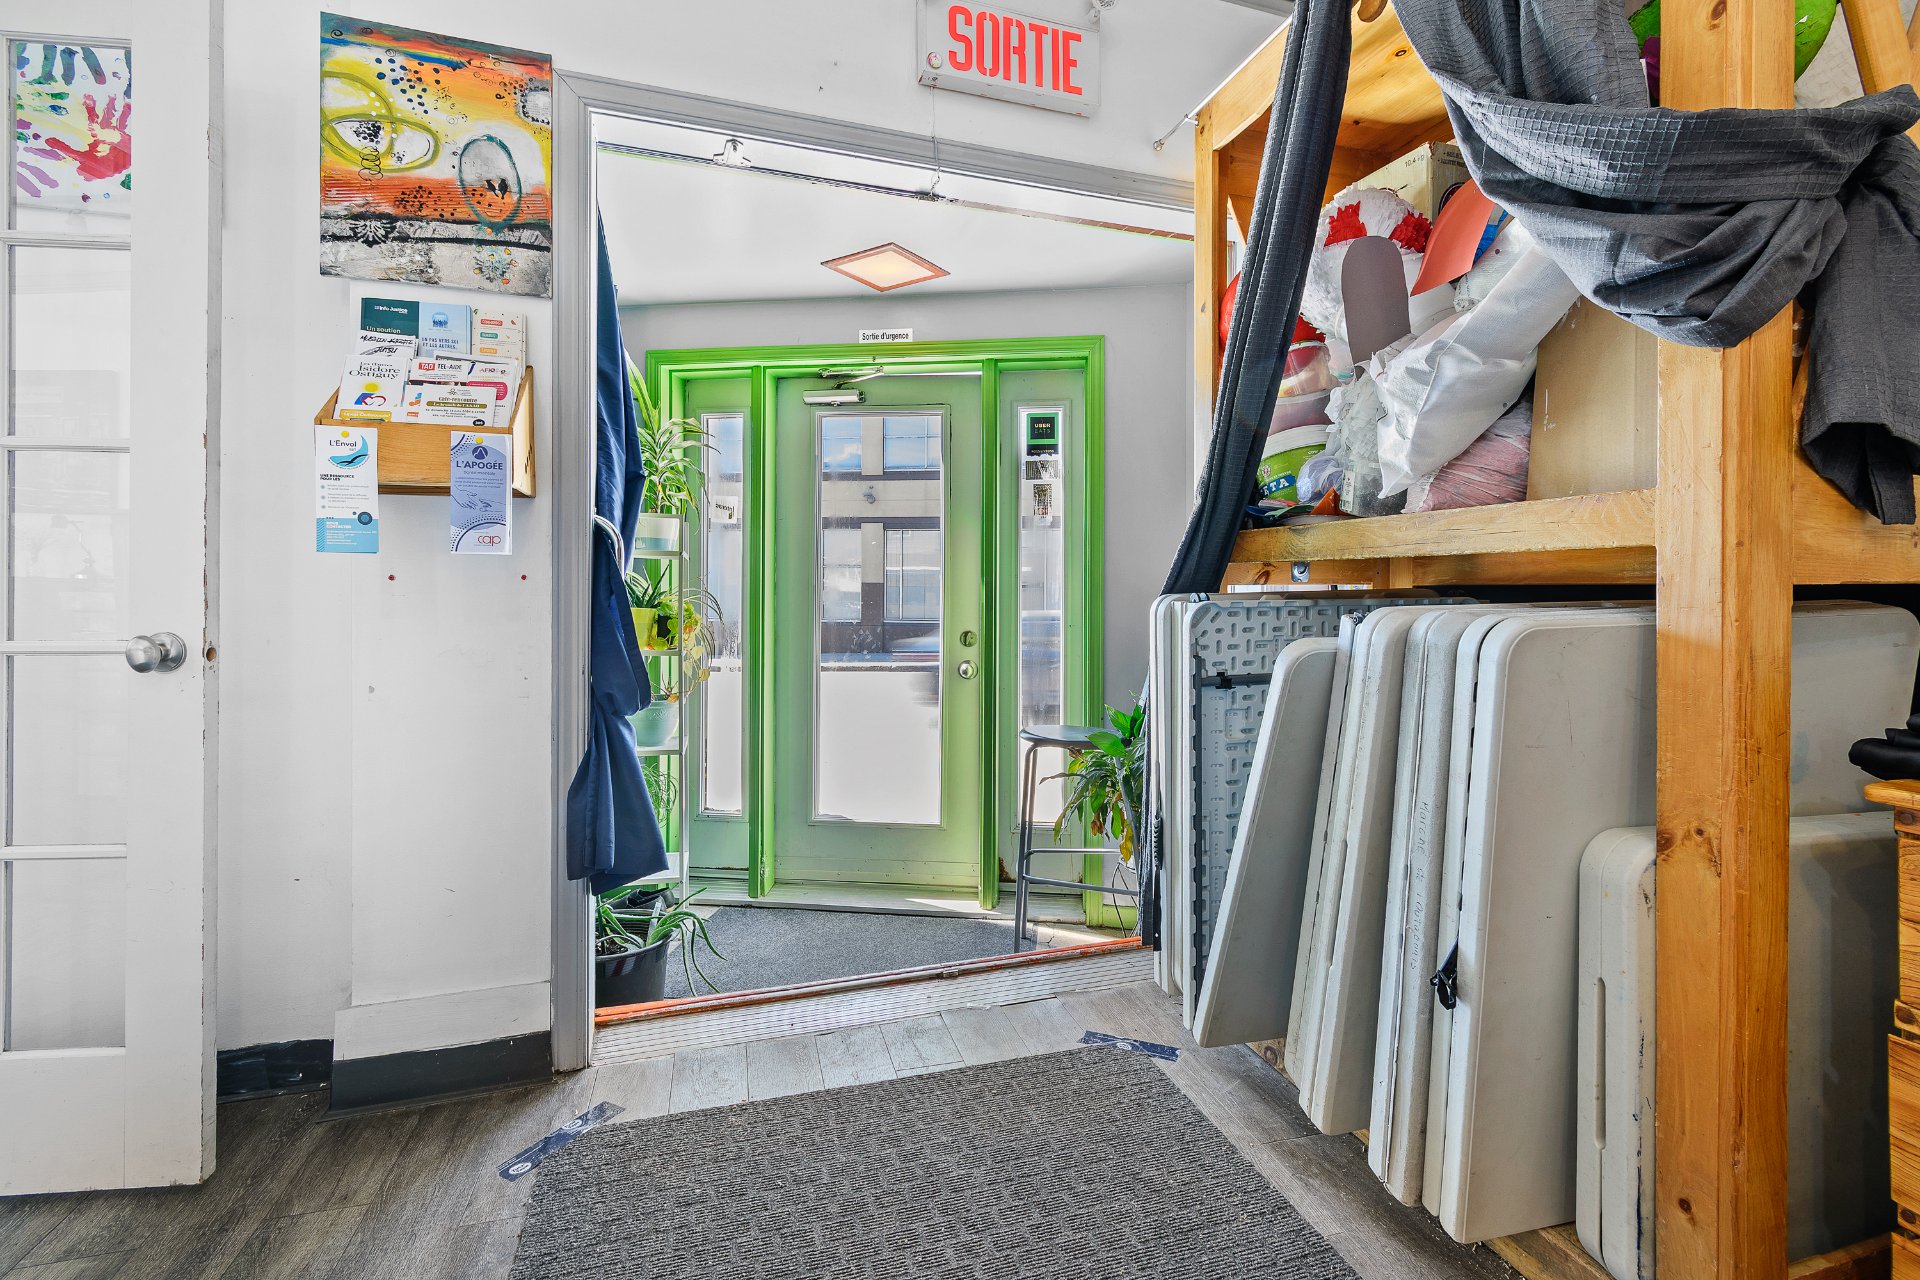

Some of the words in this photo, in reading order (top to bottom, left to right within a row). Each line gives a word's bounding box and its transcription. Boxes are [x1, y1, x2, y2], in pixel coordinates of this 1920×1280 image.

[948, 5, 1083, 96] SORTIE
[862, 332, 880, 340] Sortie
[880, 332, 910, 342] d'urgence
[349, 370, 398, 380] Ostiguy
[456, 460, 504, 470] L'APOGÉE
[478, 536, 501, 546] cap
